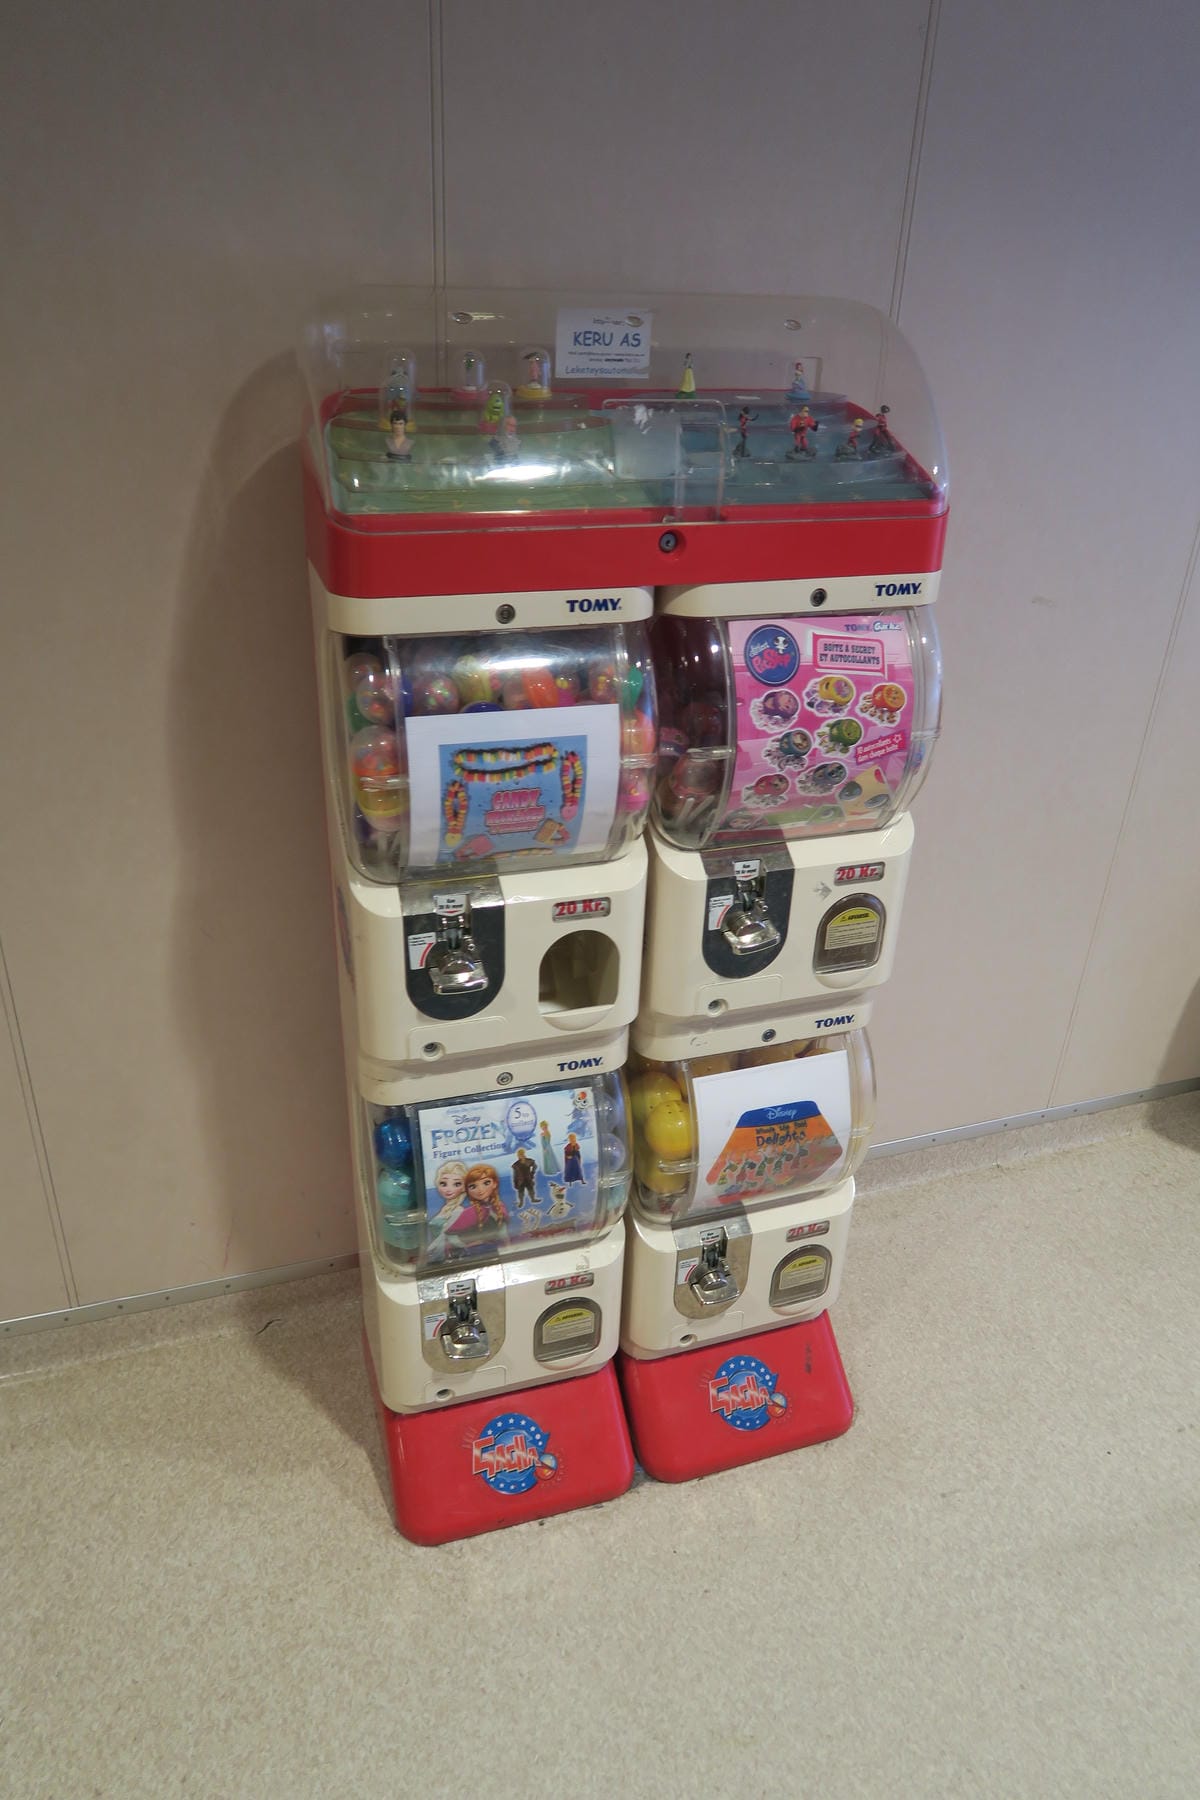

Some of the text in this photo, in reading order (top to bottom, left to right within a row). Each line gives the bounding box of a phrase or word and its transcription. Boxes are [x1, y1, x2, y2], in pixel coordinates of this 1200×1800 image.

[573, 331, 641, 348] KERU AS
[875, 582, 922, 597] TOMY
[566, 597, 622, 613] TOMY
[844, 624, 871, 632] TOMY
[831, 655, 880, 665] AUTOCOLLANTS
[837, 867, 856, 880] 20
[555, 901, 577, 917] 20
[815, 1014, 855, 1029] TOMY
[557, 1056, 603, 1072] TOMY
[452, 1114, 481, 1125] Disney
[514, 1107, 521, 1119] 5
[765, 1107, 797, 1120] Disney
[431, 1121, 506, 1150] FROZEN
[433, 1142, 506, 1159] Figure Collection
